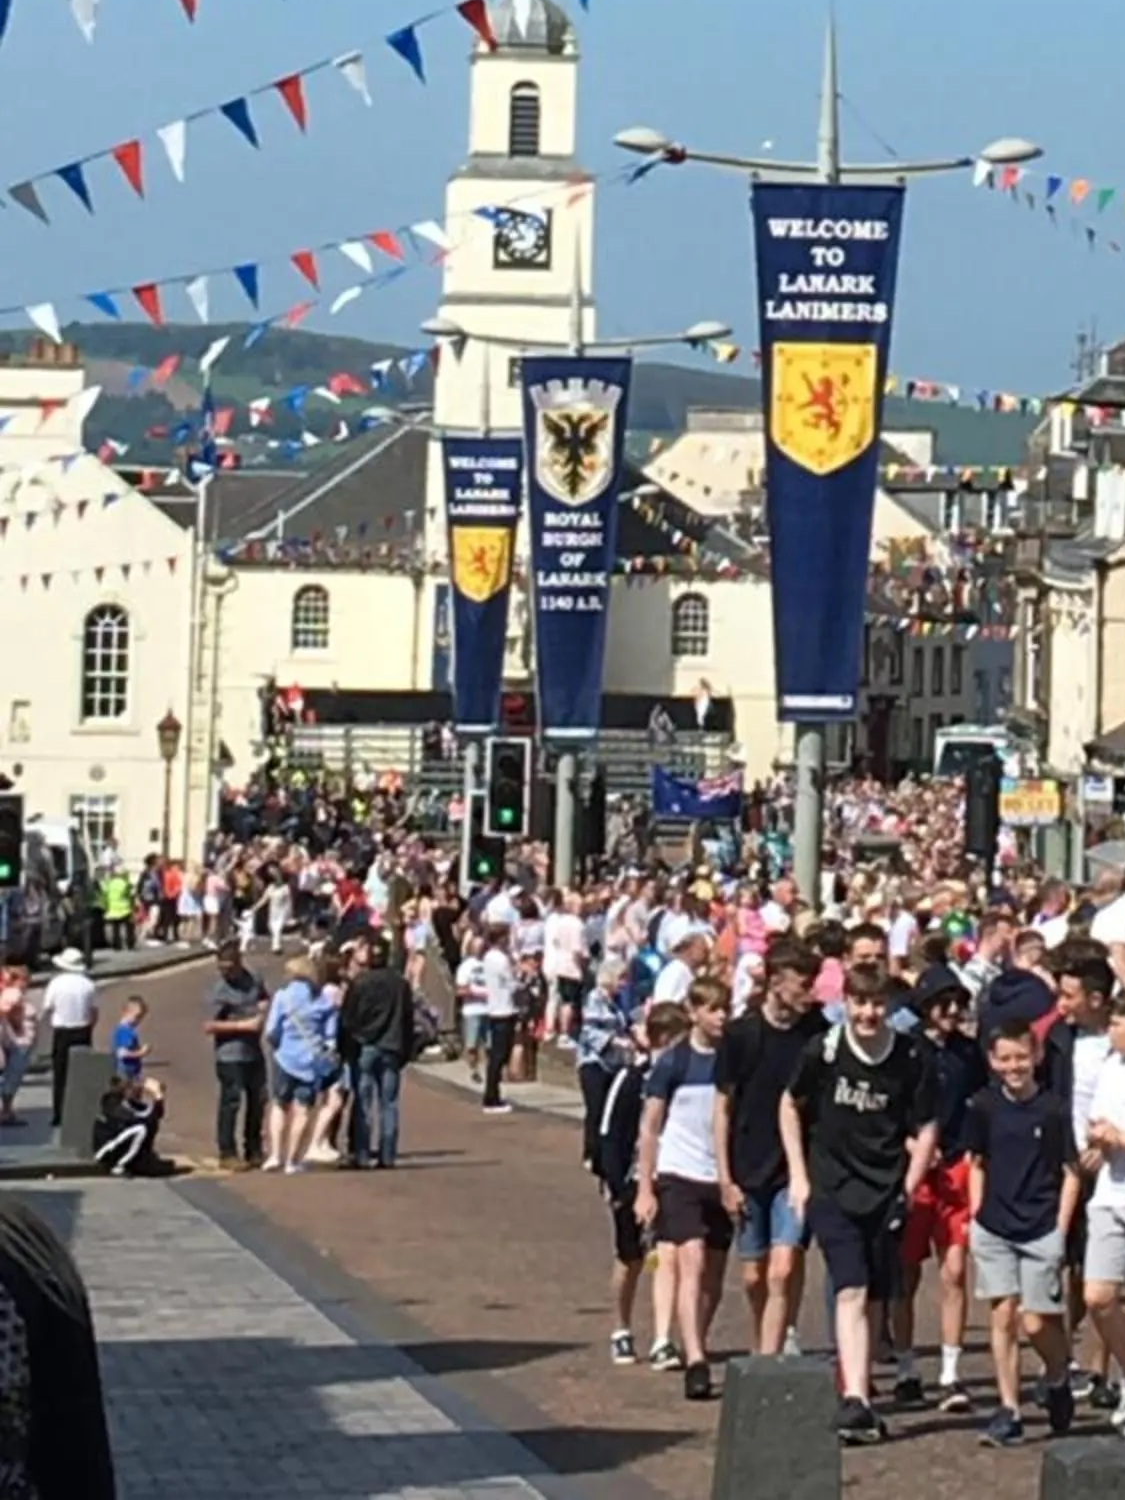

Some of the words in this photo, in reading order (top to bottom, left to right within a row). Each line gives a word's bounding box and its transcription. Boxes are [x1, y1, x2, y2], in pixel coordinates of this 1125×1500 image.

[767, 217, 889, 240] WELCOME
[810, 246, 845, 267] TO
[778, 272, 876, 295] LANARK
[765, 299, 888, 323] LANIMERS
[543, 511, 604, 529] ROYAL
[559, 551, 587, 568] OF
